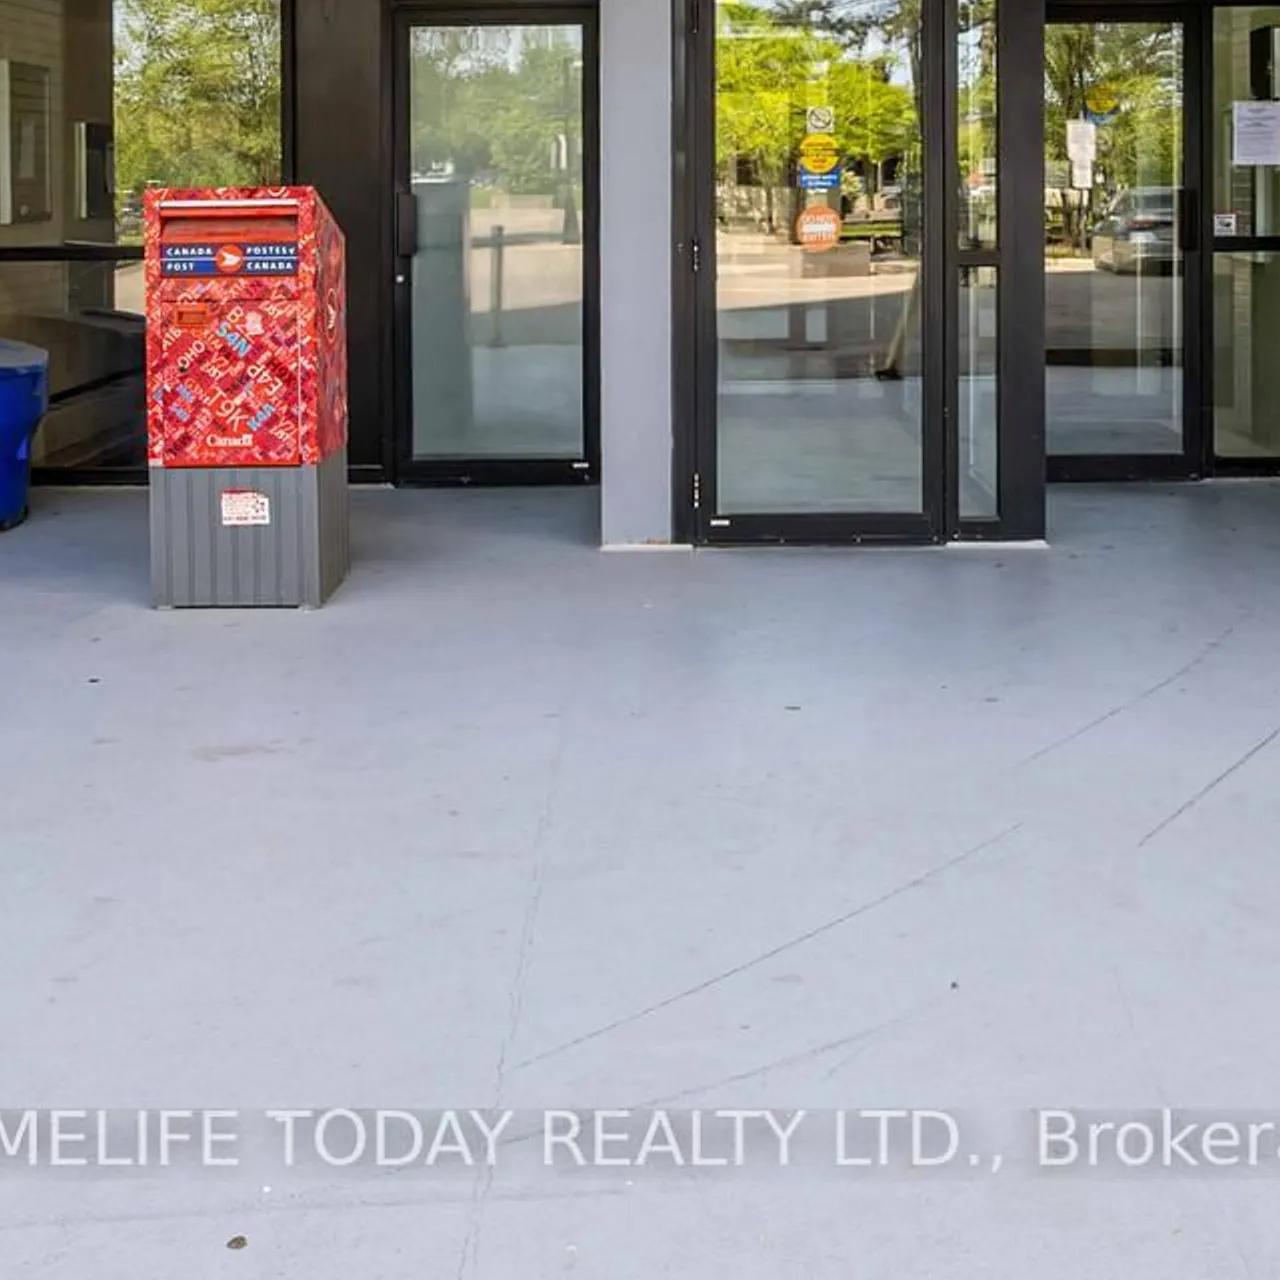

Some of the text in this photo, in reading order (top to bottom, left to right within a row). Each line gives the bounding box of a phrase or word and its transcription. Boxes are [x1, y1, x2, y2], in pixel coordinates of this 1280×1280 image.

[166, 247, 213, 256] CANADA
[166, 262, 195, 271] POST
[246, 261, 293, 270] CANADA
[206, 385, 250, 433] T9K
[206, 433, 253, 448] Canada
